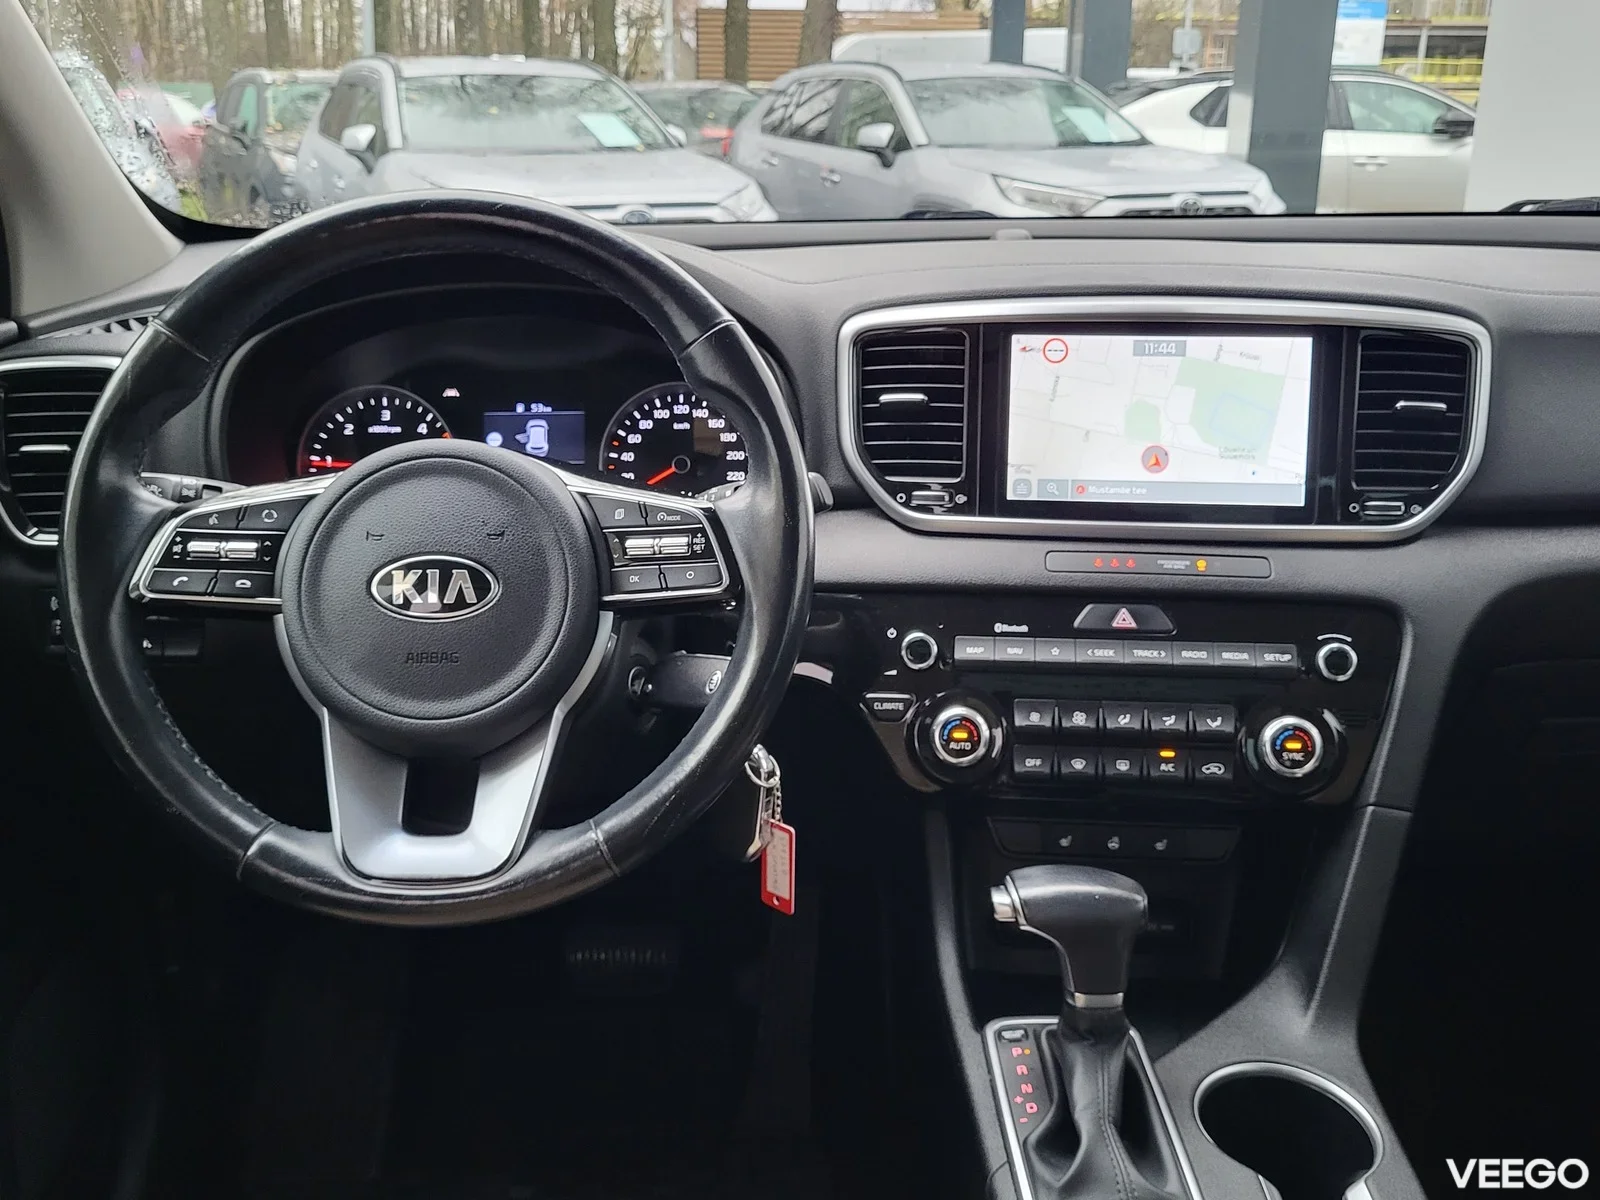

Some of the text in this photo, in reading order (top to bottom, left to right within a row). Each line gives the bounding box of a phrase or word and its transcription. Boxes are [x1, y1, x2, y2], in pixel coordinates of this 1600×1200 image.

[1144, 342, 1177, 354] 11:44
[380, 409, 391, 421] 3
[653, 408, 671, 419] 100
[673, 404, 690, 415] 120
[692, 408, 709, 419] 140
[343, 423, 354, 435] 2
[416, 422, 428, 435] 4
[638, 419, 654, 430] 80
[707, 418, 726, 429] 160
[626, 433, 642, 444] 60
[719, 432, 737, 442] 180
[325, 454, 332, 467] 1
[619, 451, 635, 462] 40
[726, 451, 745, 461] 200
[726, 470, 746, 481] 220
[629, 575, 640, 583] OK
[391, 569, 478, 605] KIA
[966, 646, 985, 655] MAP
[1006, 647, 1024, 655] NAV
[1181, 650, 1207, 659] RADIO
[1221, 651, 1249, 661] MEDIA
[405, 651, 461, 665] AIRBAG
[1263, 653, 1292, 662] SETUP
[873, 702, 905, 711] CLIMATE
[949, 741, 972, 751] AUTO
[1281, 751, 1306, 761] SYNC
[1024, 758, 1043, 767] OFF
[1011, 1046, 1023, 1058] P
[1016, 1064, 1029, 1076] R
[1021, 1083, 1034, 1094] N
[1025, 1102, 1038, 1114] D
